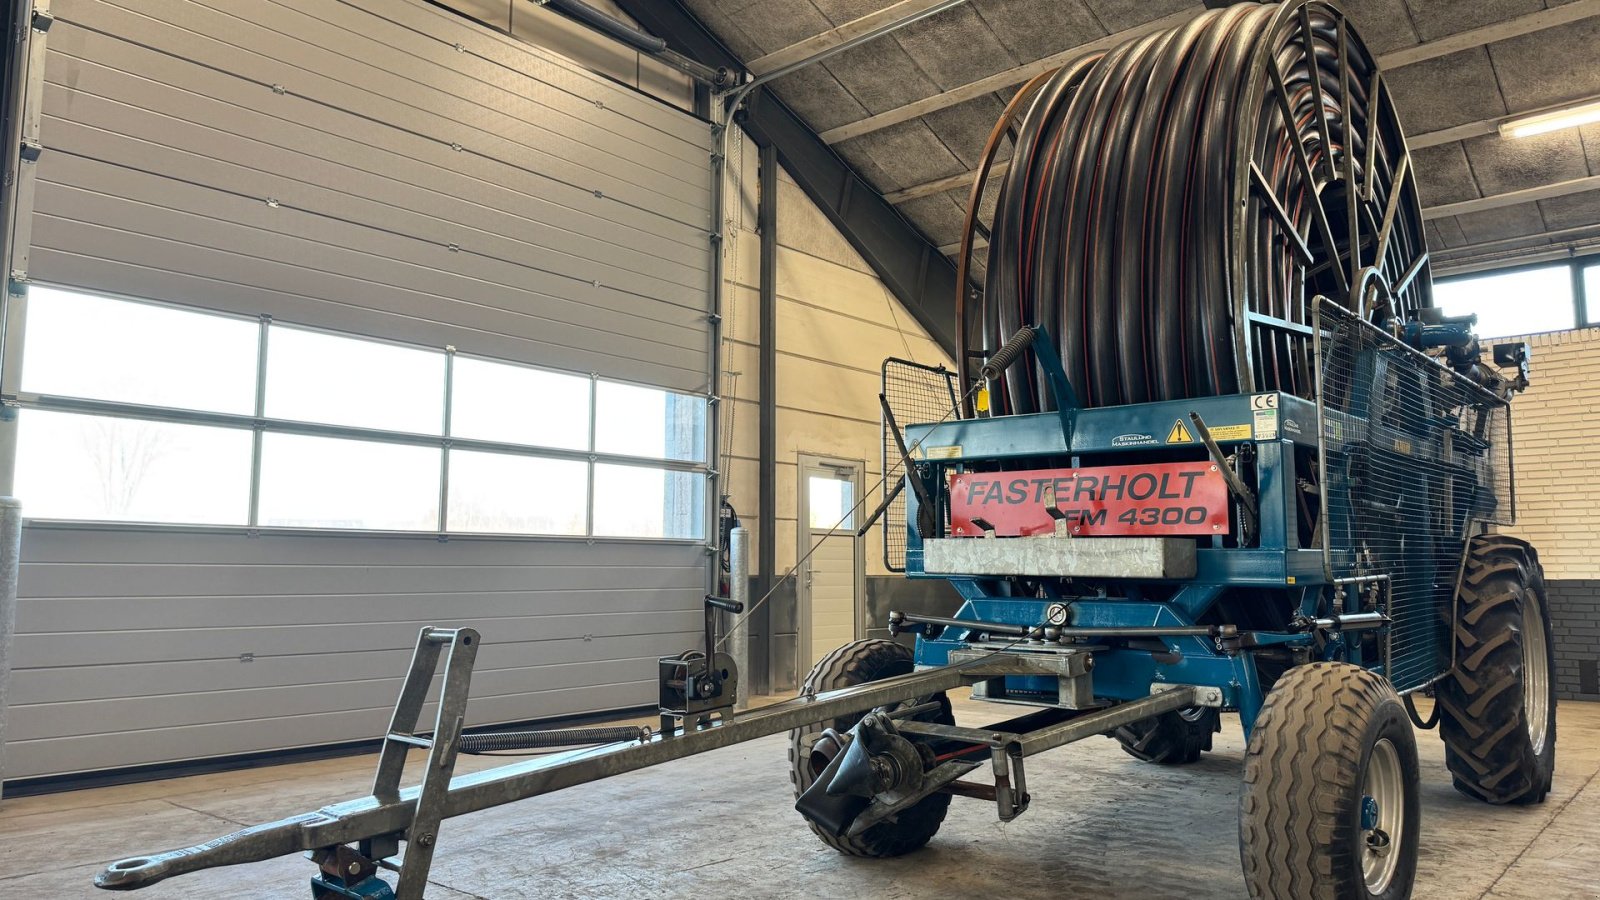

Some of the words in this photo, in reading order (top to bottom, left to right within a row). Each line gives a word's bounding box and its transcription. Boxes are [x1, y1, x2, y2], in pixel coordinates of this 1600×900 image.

[1111, 439, 1160, 447] MASKINHANDEL
[966, 471, 1205, 506] FASTERHOLT
[1118, 507, 1207, 526] 4300
